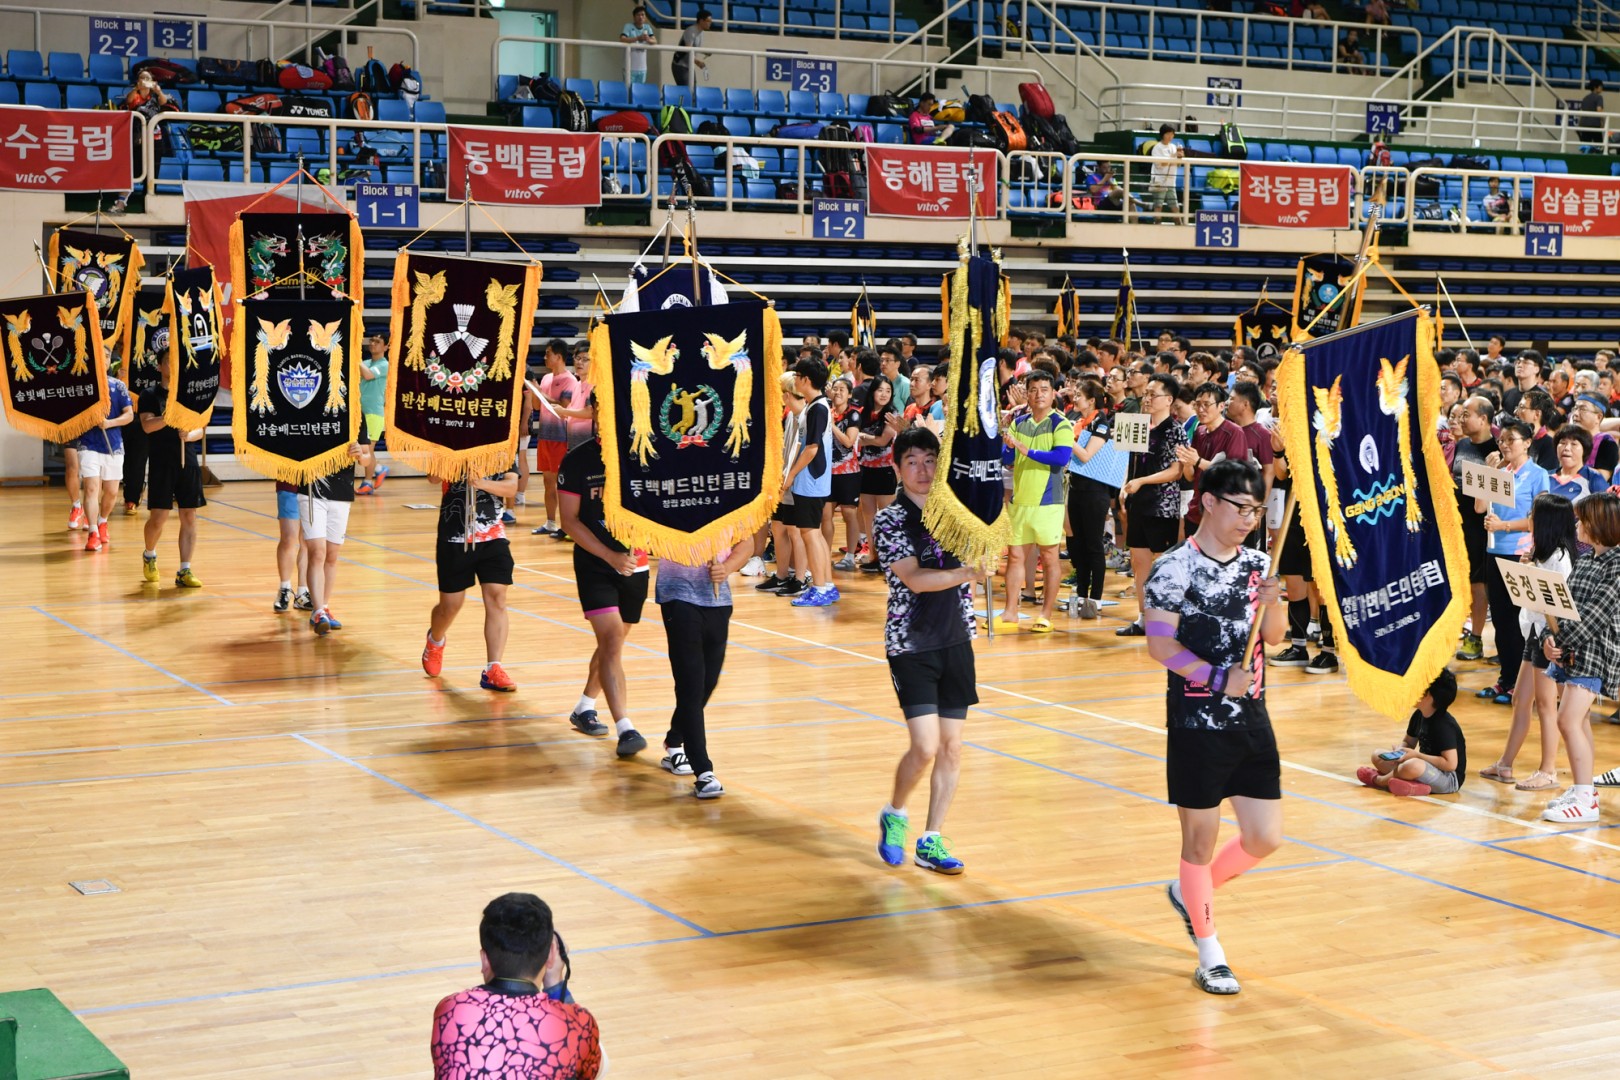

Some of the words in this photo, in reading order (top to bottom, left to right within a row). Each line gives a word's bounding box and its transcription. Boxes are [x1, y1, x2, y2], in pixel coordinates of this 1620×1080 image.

[94, 20, 118, 30] Block
[98, 34, 139, 56] 2-2
[772, 63, 791, 80] 3-
[796, 61, 815, 70] Block
[799, 73, 831, 93] 2-3
[305, 107, 329, 117] YONEX
[1368, 104, 1385, 112] Block
[1371, 115, 1395, 132] 2-4
[0, 122, 114, 162] 수클럽
[463, 141, 586, 180] 동백클럽
[15, 169, 47, 184] vitro
[880, 159, 985, 193] 동해클럽
[362, 185, 388, 197] Block
[394, 185, 413, 197] 블록
[504, 188, 532, 200] vitro
[1248, 175, 1340, 207] 좌동클럽
[818, 202, 839, 212] Block
[916, 203, 939, 212] vitro
[1540, 186, 1620, 217] 삼솔클럽
[368, 202, 407, 225] 1-1
[1199, 213, 1218, 222] Block
[1277, 214, 1299, 224] vitro
[821, 216, 857, 238] 1-2
[1528, 224, 1545, 233] Block
[1565, 224, 1584, 233] vitro
[1202, 226, 1233, 247] 1-3
[1531, 237, 1557, 256] 1-4
[14, 383, 95, 403] 솔빛배드민턴클럽
[400, 391, 508, 418] 반산배드민턴클럽
[255, 420, 341, 437] 삼솔배드민턴클럽
[1116, 421, 1148, 444] 삼어클럽
[629, 471, 751, 498] 동백배드민턴클럽
[1464, 469, 1511, 497] 솔빛클럽
[680, 495, 721, 508] 2004.9.4
[1504, 571, 1574, 611] 송정클럽
